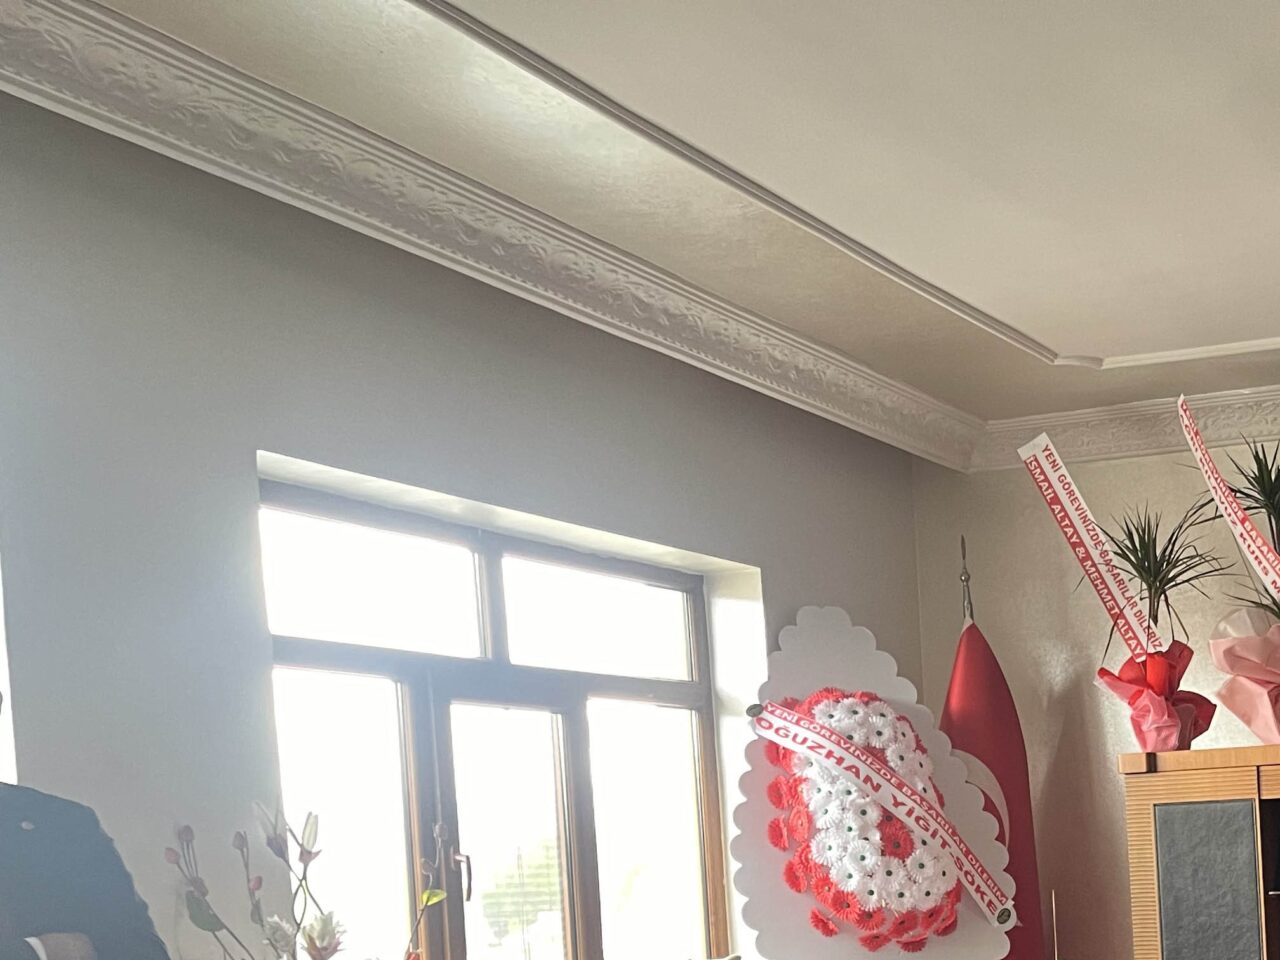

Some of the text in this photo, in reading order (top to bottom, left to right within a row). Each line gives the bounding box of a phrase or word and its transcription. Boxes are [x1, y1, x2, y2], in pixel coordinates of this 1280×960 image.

[1026, 454, 1145, 656] İSMAİL ALTAY & MEHMET ALTAY
[1041, 444, 1163, 650] YENİ GÖREVİNİZDE BAŞARILAR DİLERİZ
[1239, 532, 1269, 577] KURS
[755, 716, 998, 916] OĞUZHAN YİĞİT-SÖKE
[765, 703, 1007, 905] YENİ GÖREVİNİZDE BAŞARILAR DİLERİM
